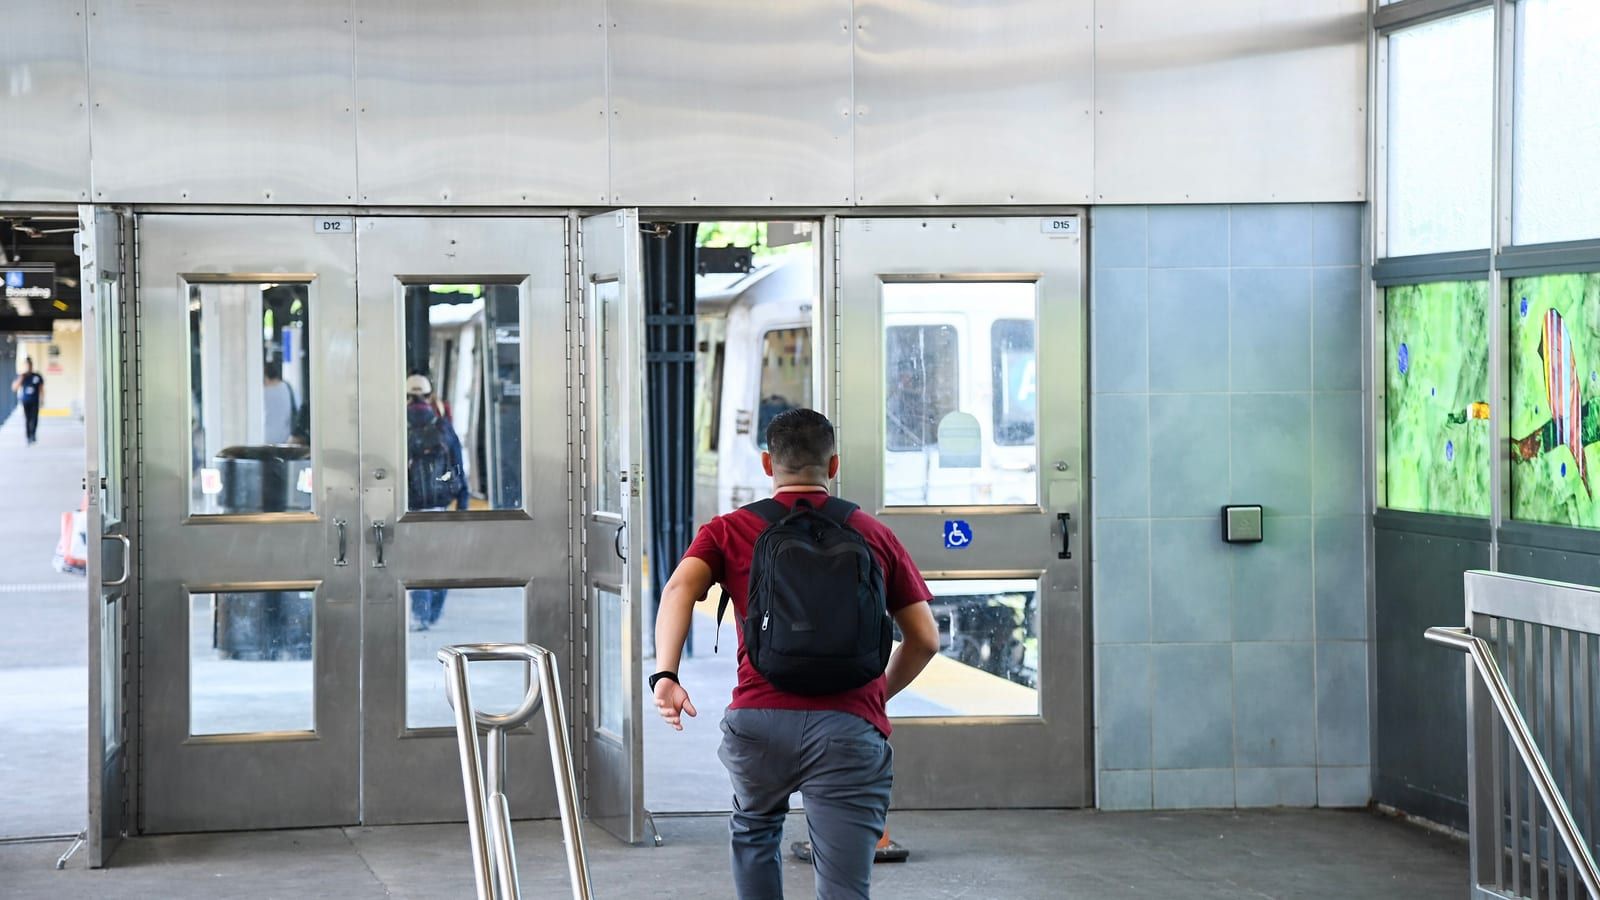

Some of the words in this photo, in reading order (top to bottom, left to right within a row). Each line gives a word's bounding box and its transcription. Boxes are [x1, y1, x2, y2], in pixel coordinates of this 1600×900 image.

[323, 221, 341, 231] D12
[1053, 220, 1070, 230] D15
[5, 285, 52, 299] Boarding
